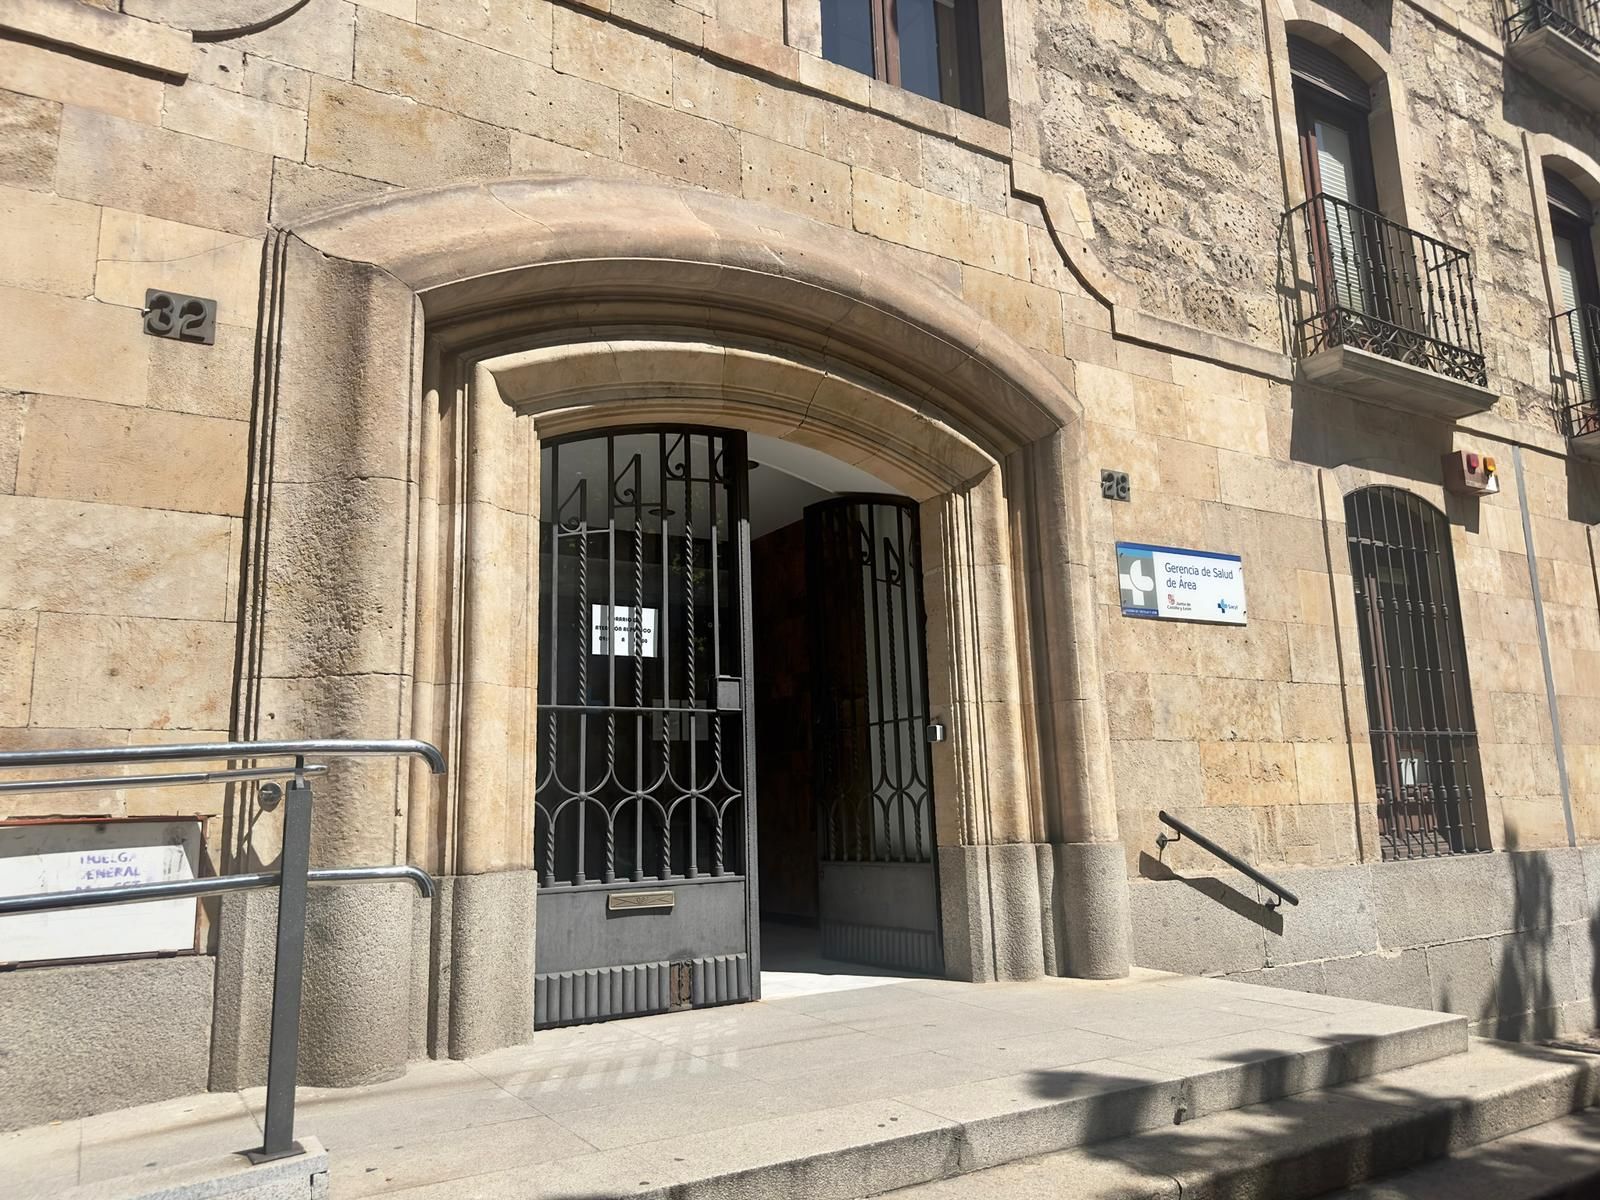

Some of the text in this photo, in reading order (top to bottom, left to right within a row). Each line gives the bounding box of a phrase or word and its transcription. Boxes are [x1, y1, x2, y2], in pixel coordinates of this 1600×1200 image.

[147, 293, 207, 342] 32
[1164, 562, 1234, 580] Gerencia de Salud
[1166, 575, 1198, 591] de Área
[81, 866, 140, 880] ENERAL
